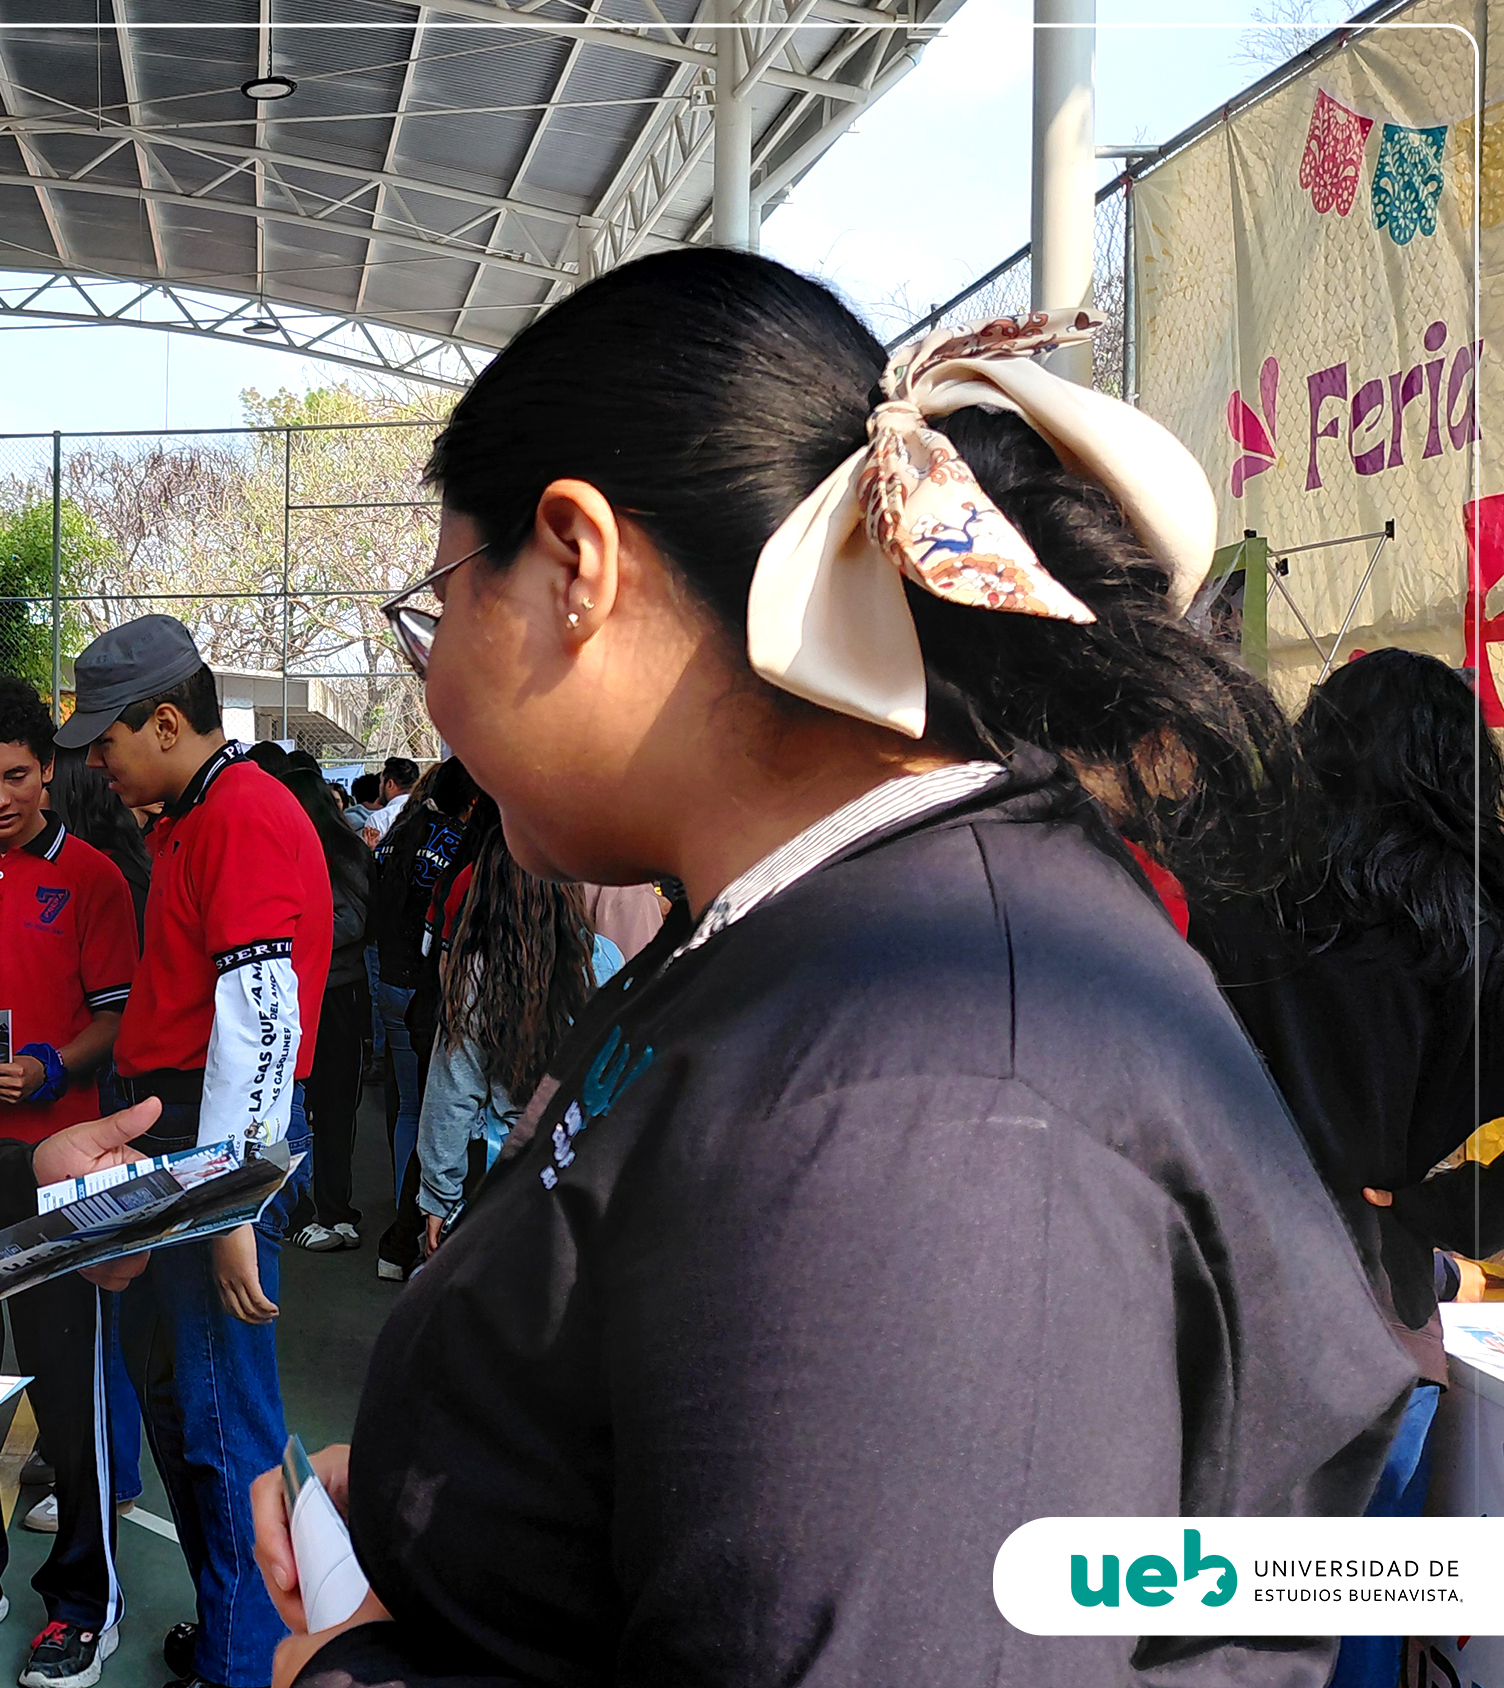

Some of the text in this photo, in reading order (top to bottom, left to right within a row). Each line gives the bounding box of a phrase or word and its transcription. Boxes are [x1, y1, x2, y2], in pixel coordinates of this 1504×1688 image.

[1304, 321, 1484, 492] Feria
[253, 1051, 272, 1084] GAS
[248, 1089, 263, 1112] LA
